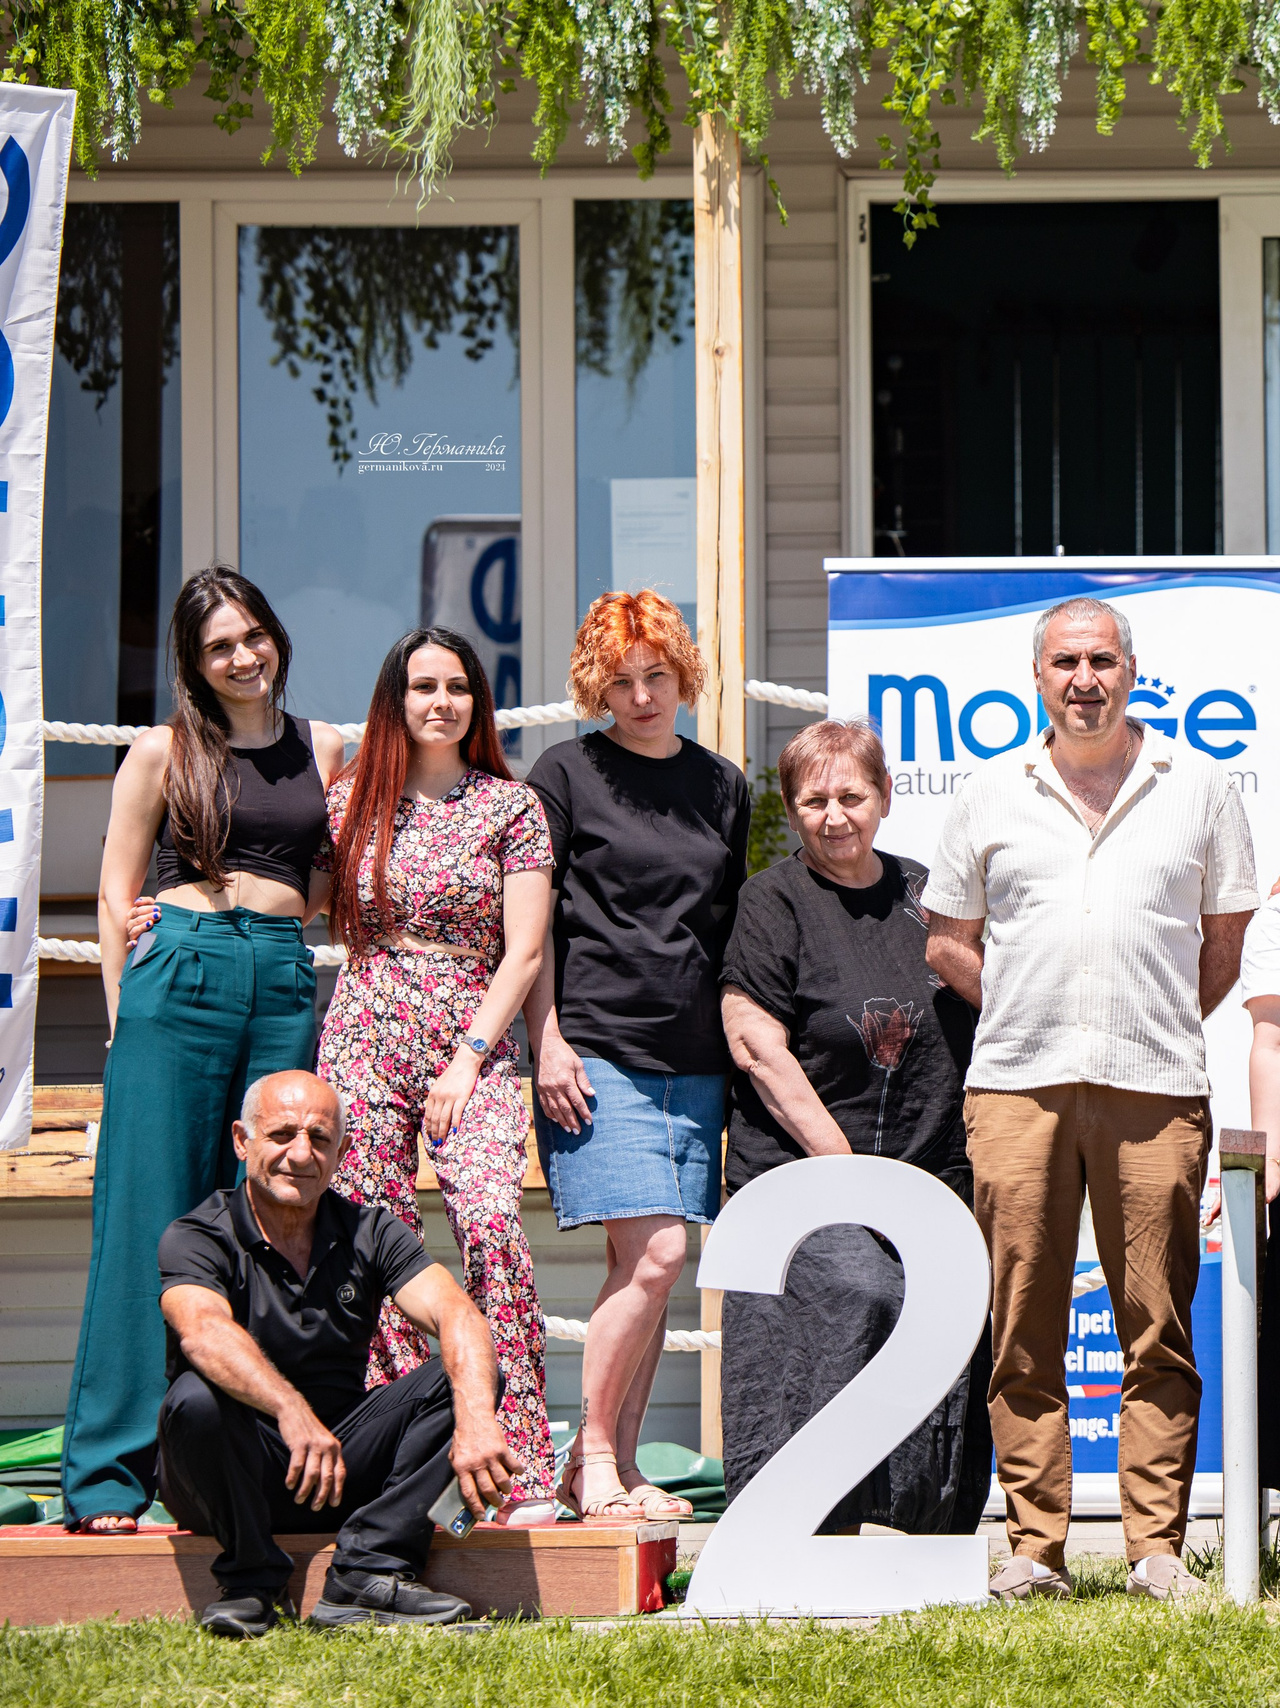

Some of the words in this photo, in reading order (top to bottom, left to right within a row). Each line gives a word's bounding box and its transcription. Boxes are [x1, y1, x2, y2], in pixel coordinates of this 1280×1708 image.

[1078, 1309, 1111, 1339] pet
[1065, 1345, 1084, 1373] el
[685, 1154, 992, 1615] 2
